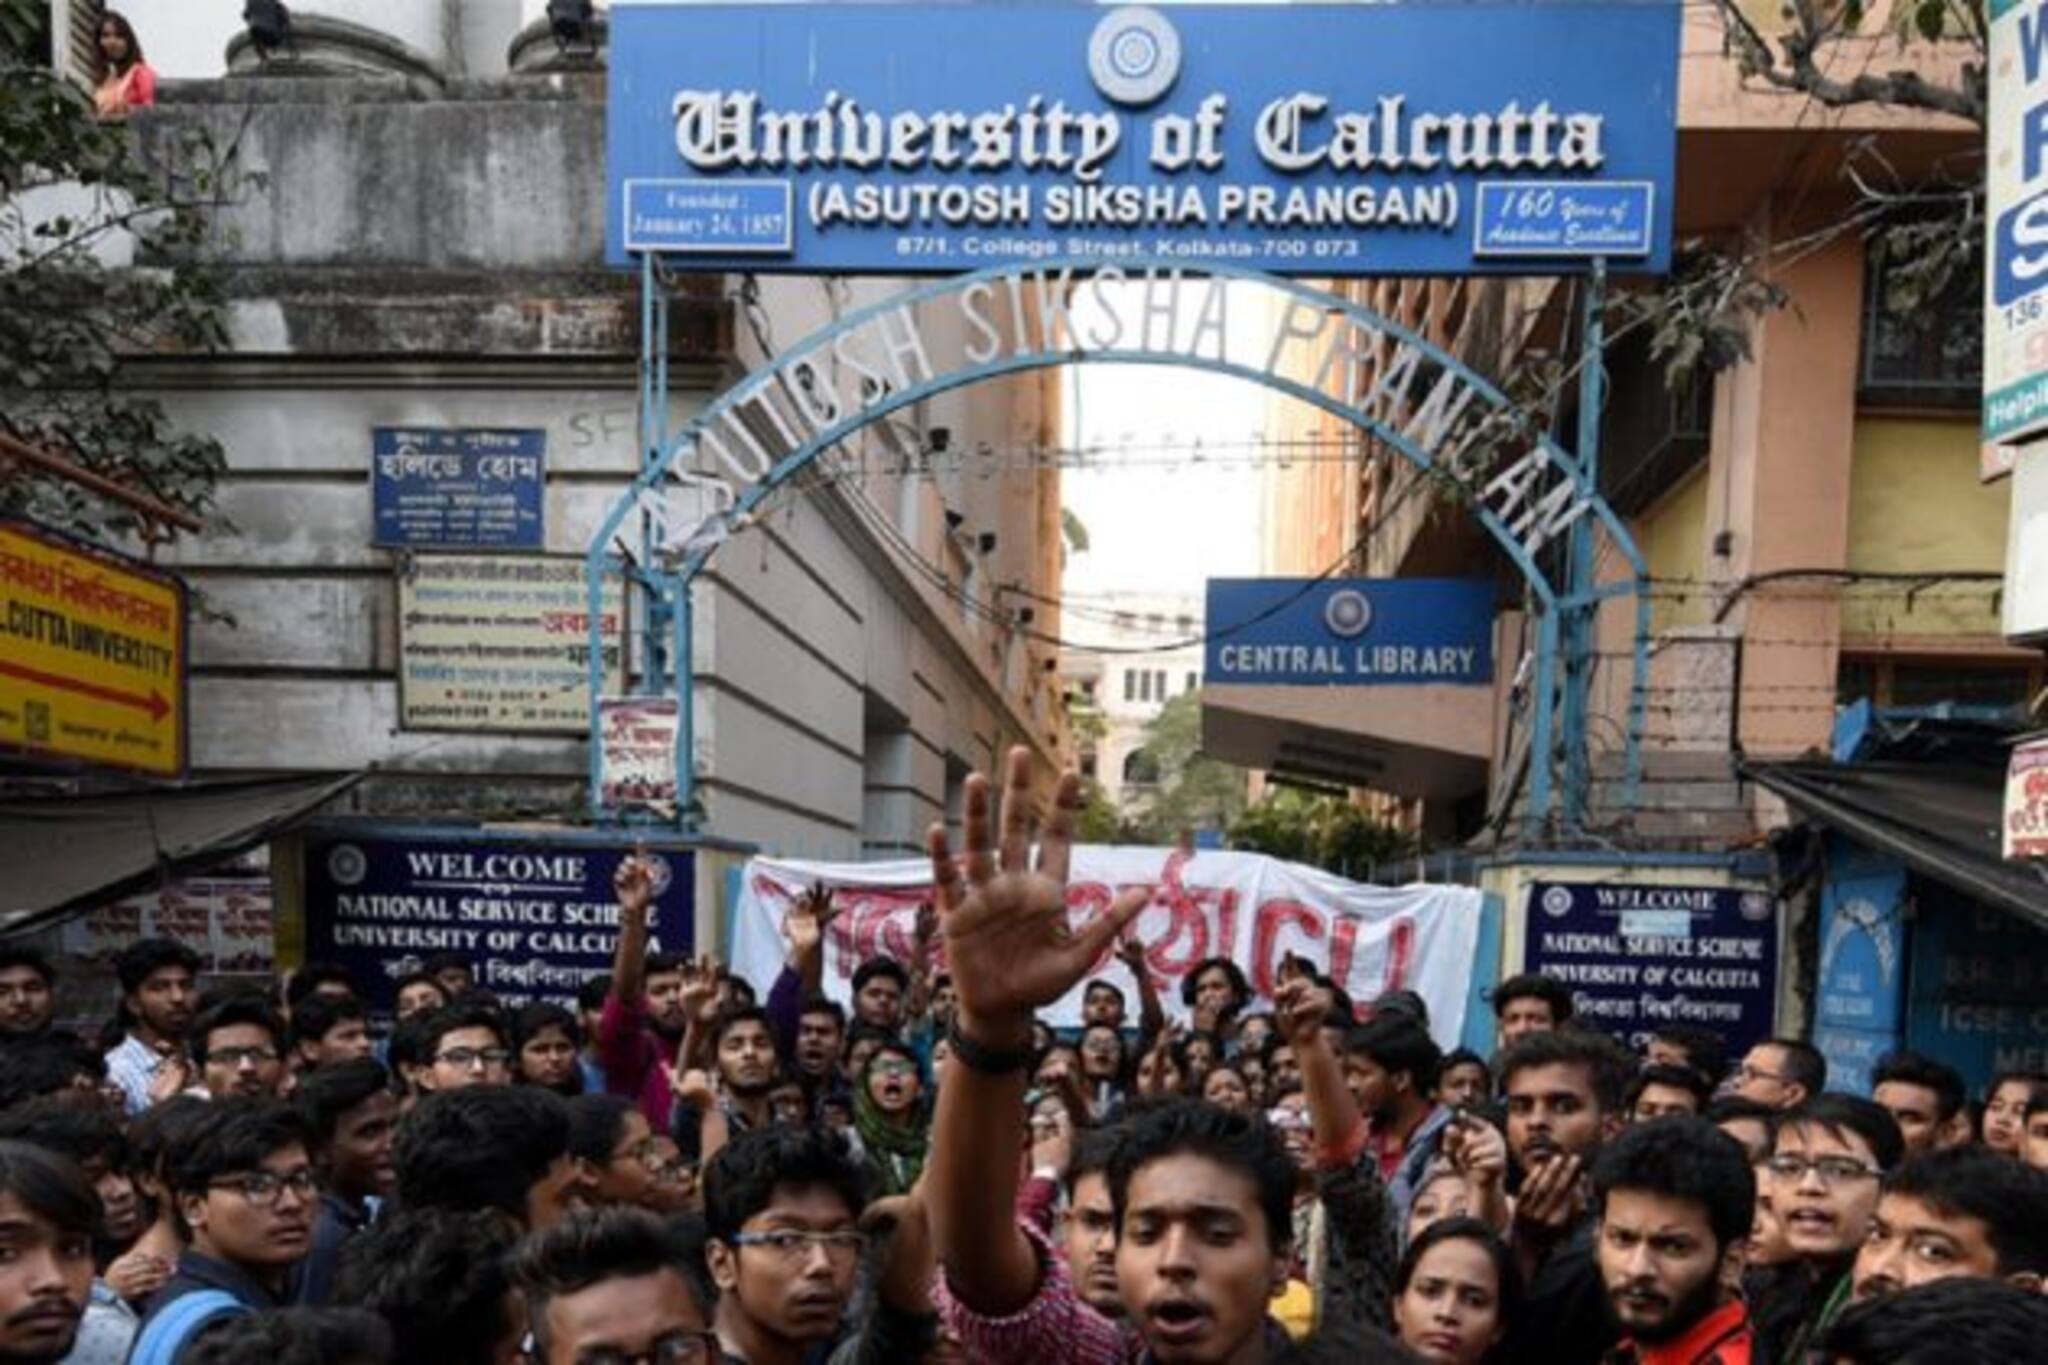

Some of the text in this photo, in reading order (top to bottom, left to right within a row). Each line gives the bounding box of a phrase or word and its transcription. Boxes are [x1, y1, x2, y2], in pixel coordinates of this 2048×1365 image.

[673, 89, 1606, 182] University of Calcutta
[808, 180, 1459, 228] (ASUTOSH SIKSHA PRANGAN)
[1500, 187, 1555, 219] 160
[632, 214, 703, 238] January
[963, 236, 1058, 258] College
[1313, 239, 1360, 257] 073
[959, 265, 1227, 365] SIKSHA
[0, 599, 174, 678] CUTTA UNIVERSITY
[1219, 646, 1475, 674] CENTRAL LIBRARY
[407, 852, 587, 883] WELCOME
[337, 895, 660, 928] NATIONAL SERVICE SCHEE
[1596, 889, 1718, 911] WELCOME
[333, 924, 662, 954] UNIVERSITY OF CALCUA
[1543, 933, 1763, 960] NATIONAL SERVICE SCHEME
[1254, 897, 1415, 1022] CU
[1540, 963, 1760, 989] UNIVERSITY OF CALCUTTA
